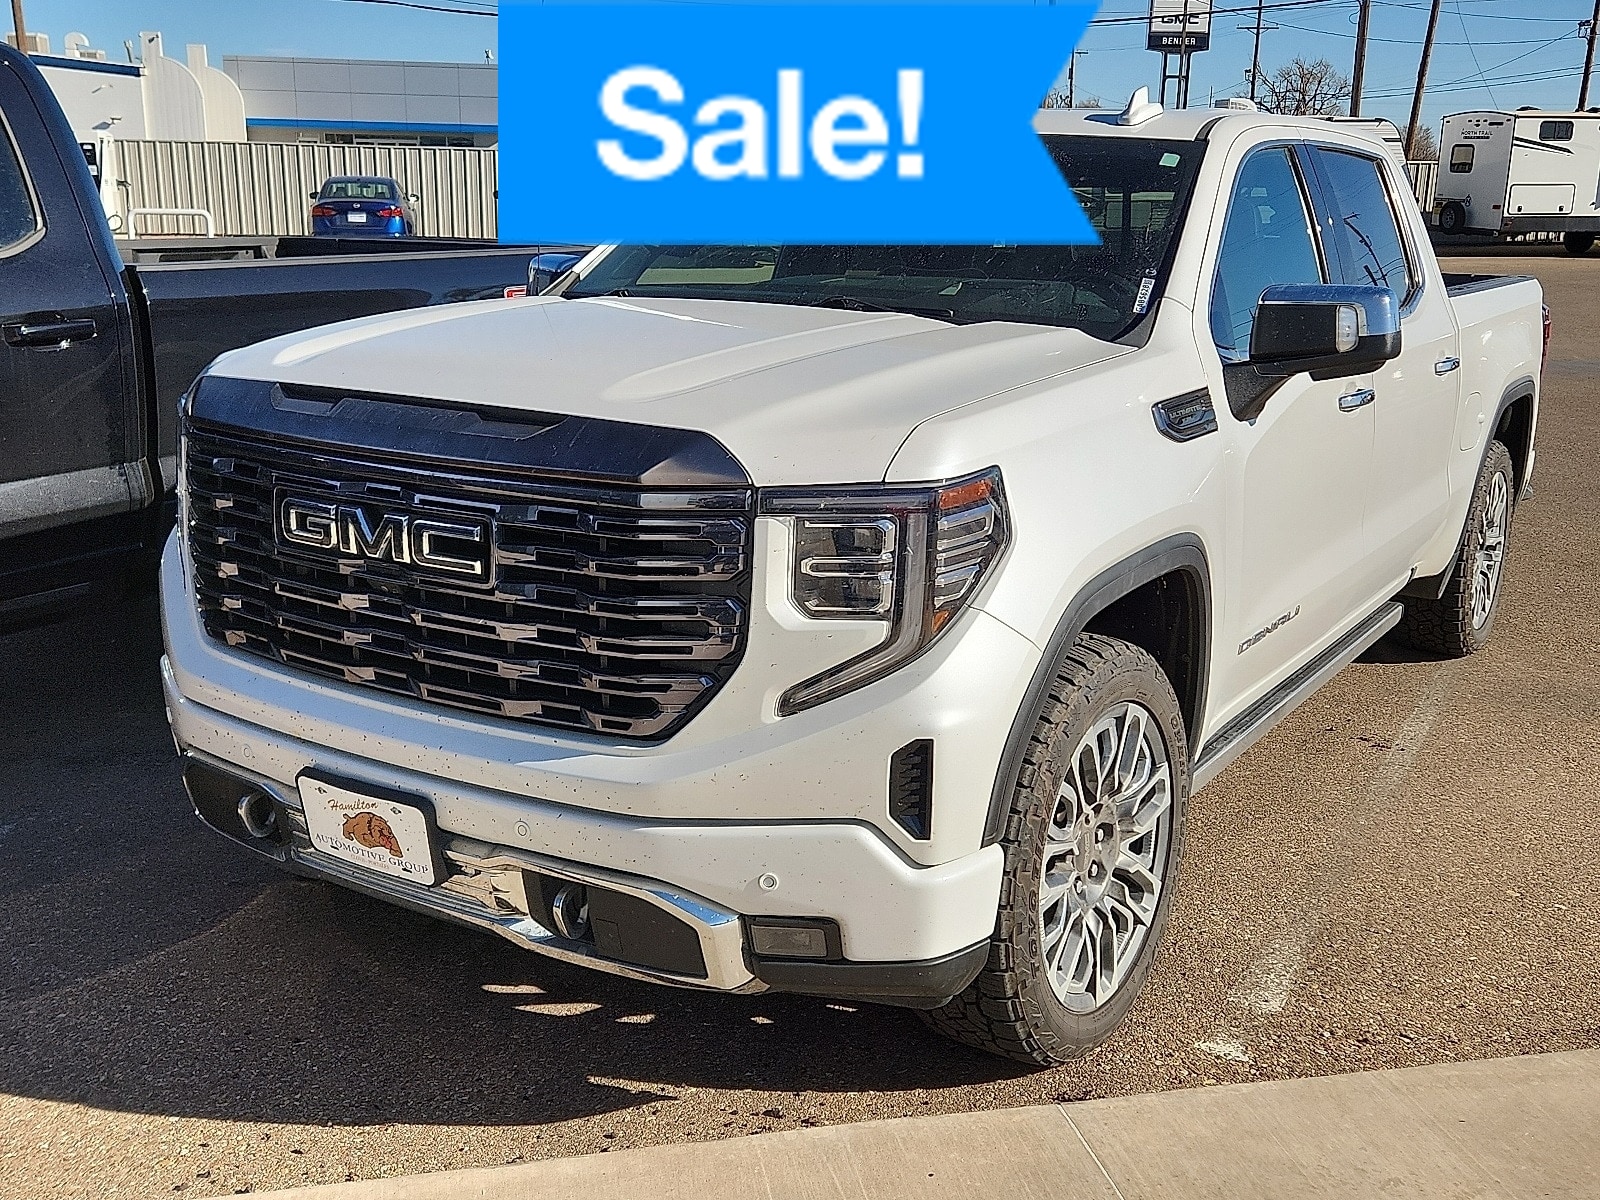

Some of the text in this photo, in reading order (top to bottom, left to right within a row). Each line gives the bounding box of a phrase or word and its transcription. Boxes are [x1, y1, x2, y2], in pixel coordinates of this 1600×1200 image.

[1161, 15, 1199, 24] GMC
[279, 497, 483, 576] GMC
[1237, 604, 1300, 656] DENALI
[327, 798, 379, 811] Hamilton
[315, 832, 386, 863] AUTOMOTIVE
[388, 856, 429, 874] GROUP
